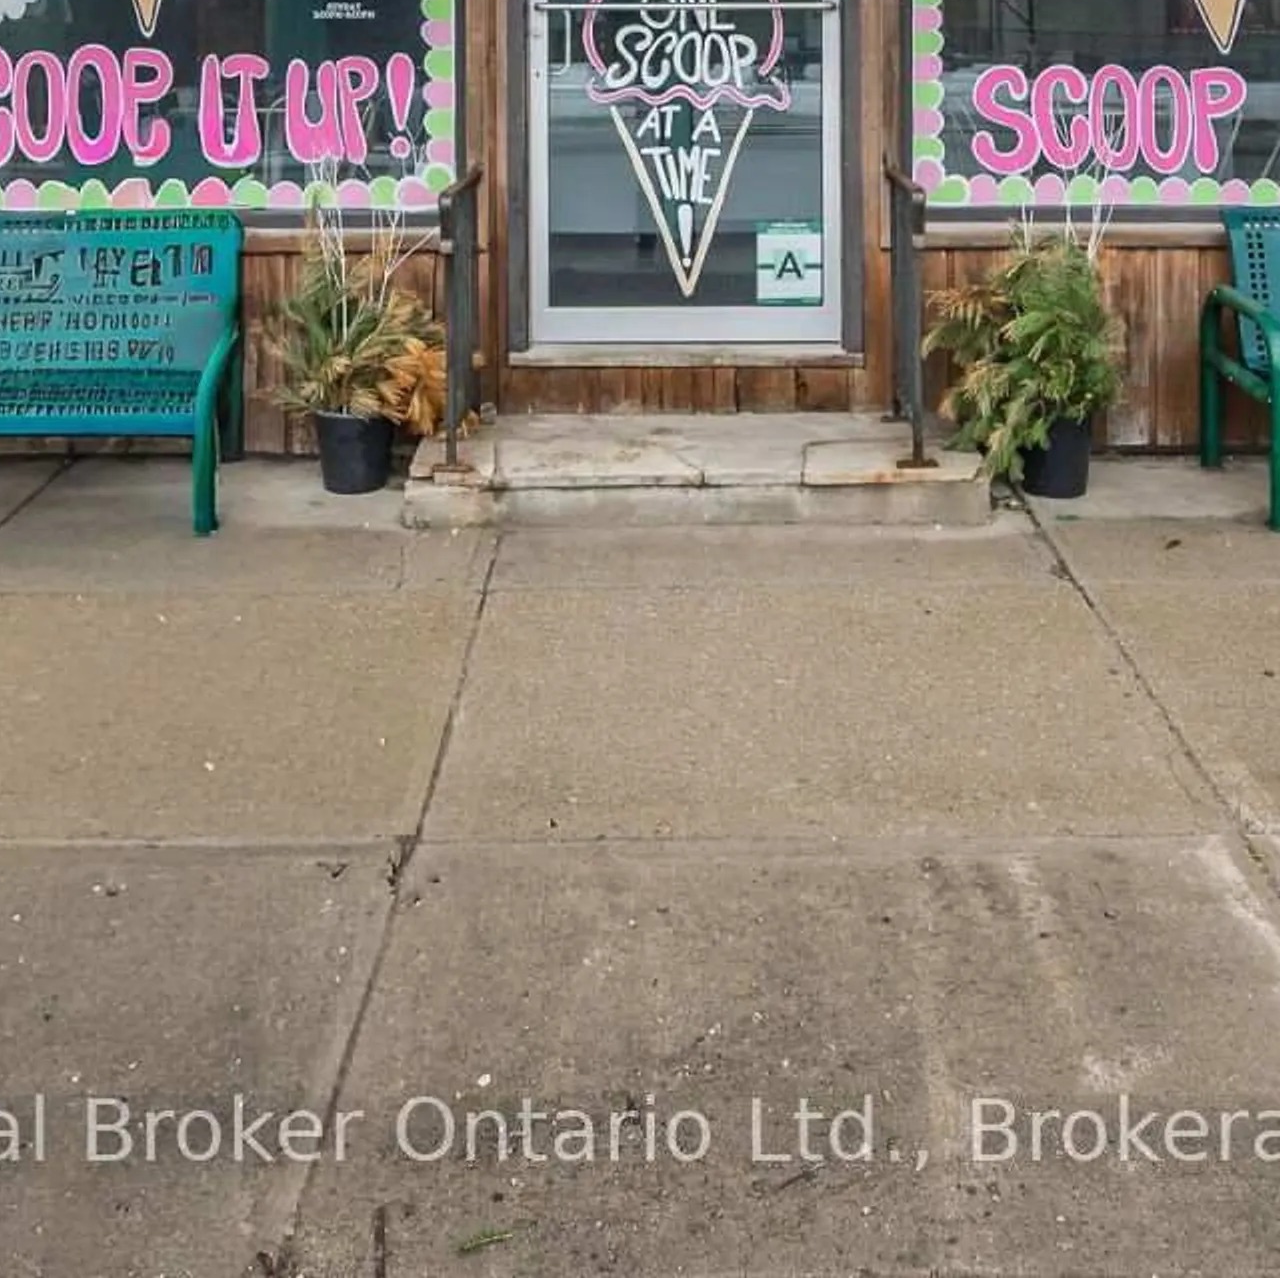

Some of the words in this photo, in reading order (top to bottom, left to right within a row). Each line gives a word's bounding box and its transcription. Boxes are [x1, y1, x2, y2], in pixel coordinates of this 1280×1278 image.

[605, 24, 758, 89] SCOOP
[285, 52, 416, 165] UP!
[637, 105, 682, 140] AT
[692, 107, 722, 144] A
[971, 64, 1248, 175] SCOOP
[775, 250, 804, 281] A
